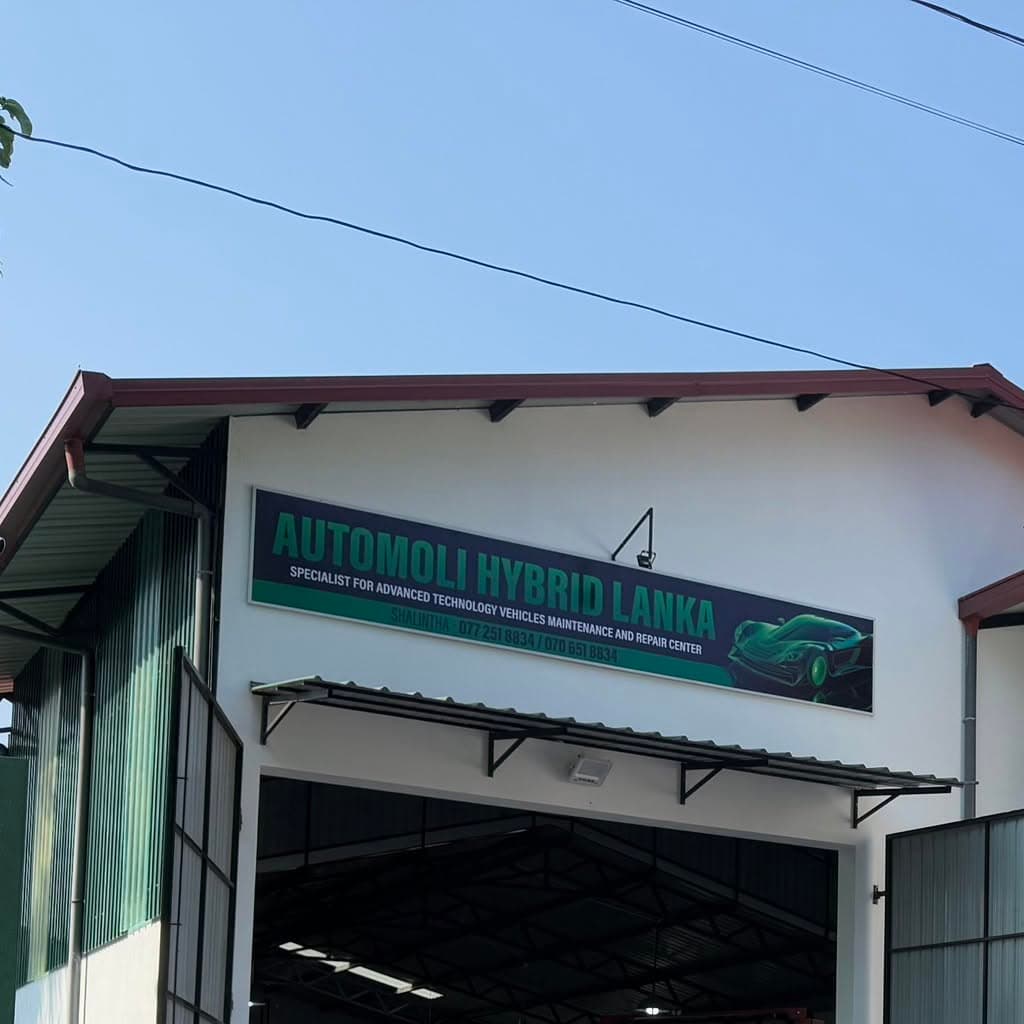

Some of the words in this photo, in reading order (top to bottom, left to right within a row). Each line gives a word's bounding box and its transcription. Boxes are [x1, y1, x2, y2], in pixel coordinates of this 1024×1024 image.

[272, 512, 467, 591] AUTOMOLI
[477, 553, 604, 617] HYBRID
[613, 580, 716, 640] LANKA
[290, 566, 351, 589] SPECIALIST
[353, 577, 374, 592] FOR
[376, 582, 431, 603] ADVANCED
[433, 593, 498, 616] TECHNOLOGY
[499, 606, 546, 625] VEHICLES
[548, 615, 613, 639] MAINTENANCE
[615, 629, 634, 643] AND
[636, 633, 667, 649] REPAIR
[669, 640, 702, 655] CENTER
[459, 619, 480, 637] 077
[482, 625, 501, 641] 251
[545, 636, 566, 653] 070
[568, 641, 587, 657] 651
